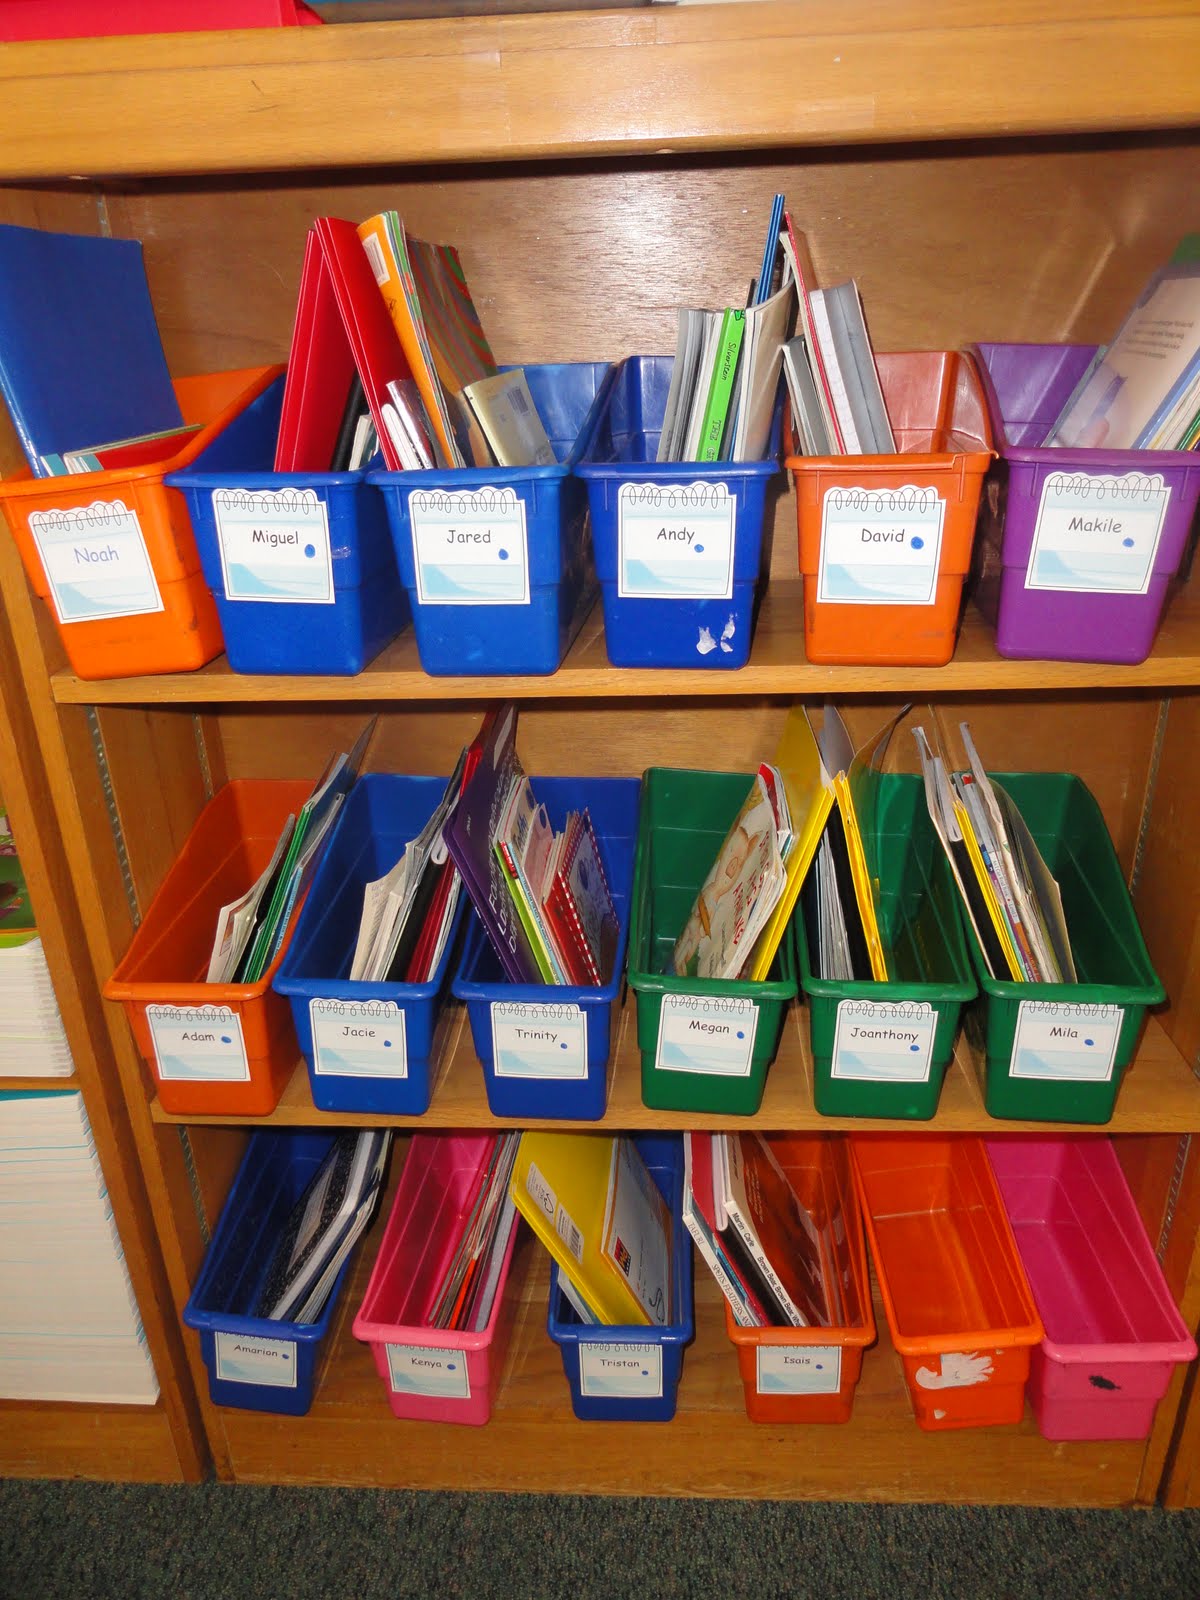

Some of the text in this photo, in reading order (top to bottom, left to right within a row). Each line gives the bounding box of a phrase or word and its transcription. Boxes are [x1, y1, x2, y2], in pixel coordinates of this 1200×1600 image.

[721, 342, 737, 381] Silverstein
[1068, 516, 1123, 538] Makile
[252, 529, 299, 548] Miguel
[446, 529, 491, 544] Jared
[656, 526, 696, 545] Andy
[861, 527, 906, 543] David
[73, 544, 120, 564] Noah
[342, 1026, 376, 1038] Jacie
[688, 1020, 730, 1035] Megan
[850, 1027, 919, 1043] Joanthony
[1049, 1026, 1079, 1039] Mila
[181, 1031, 216, 1042] Adam
[514, 1028, 558, 1043] Trinity
[732, 1213, 744, 1230] Martin
[744, 1233, 754, 1247] Carle
[756, 1255, 770, 1274] Brown
[774, 1285, 788, 1303] Brown
[723, 1284, 743, 1315] FEATHERS
[233, 1343, 278, 1357] Amarion
[411, 1356, 442, 1368] Kenya
[602, 1357, 640, 1367] Tristan
[783, 1356, 811, 1365] Isais
